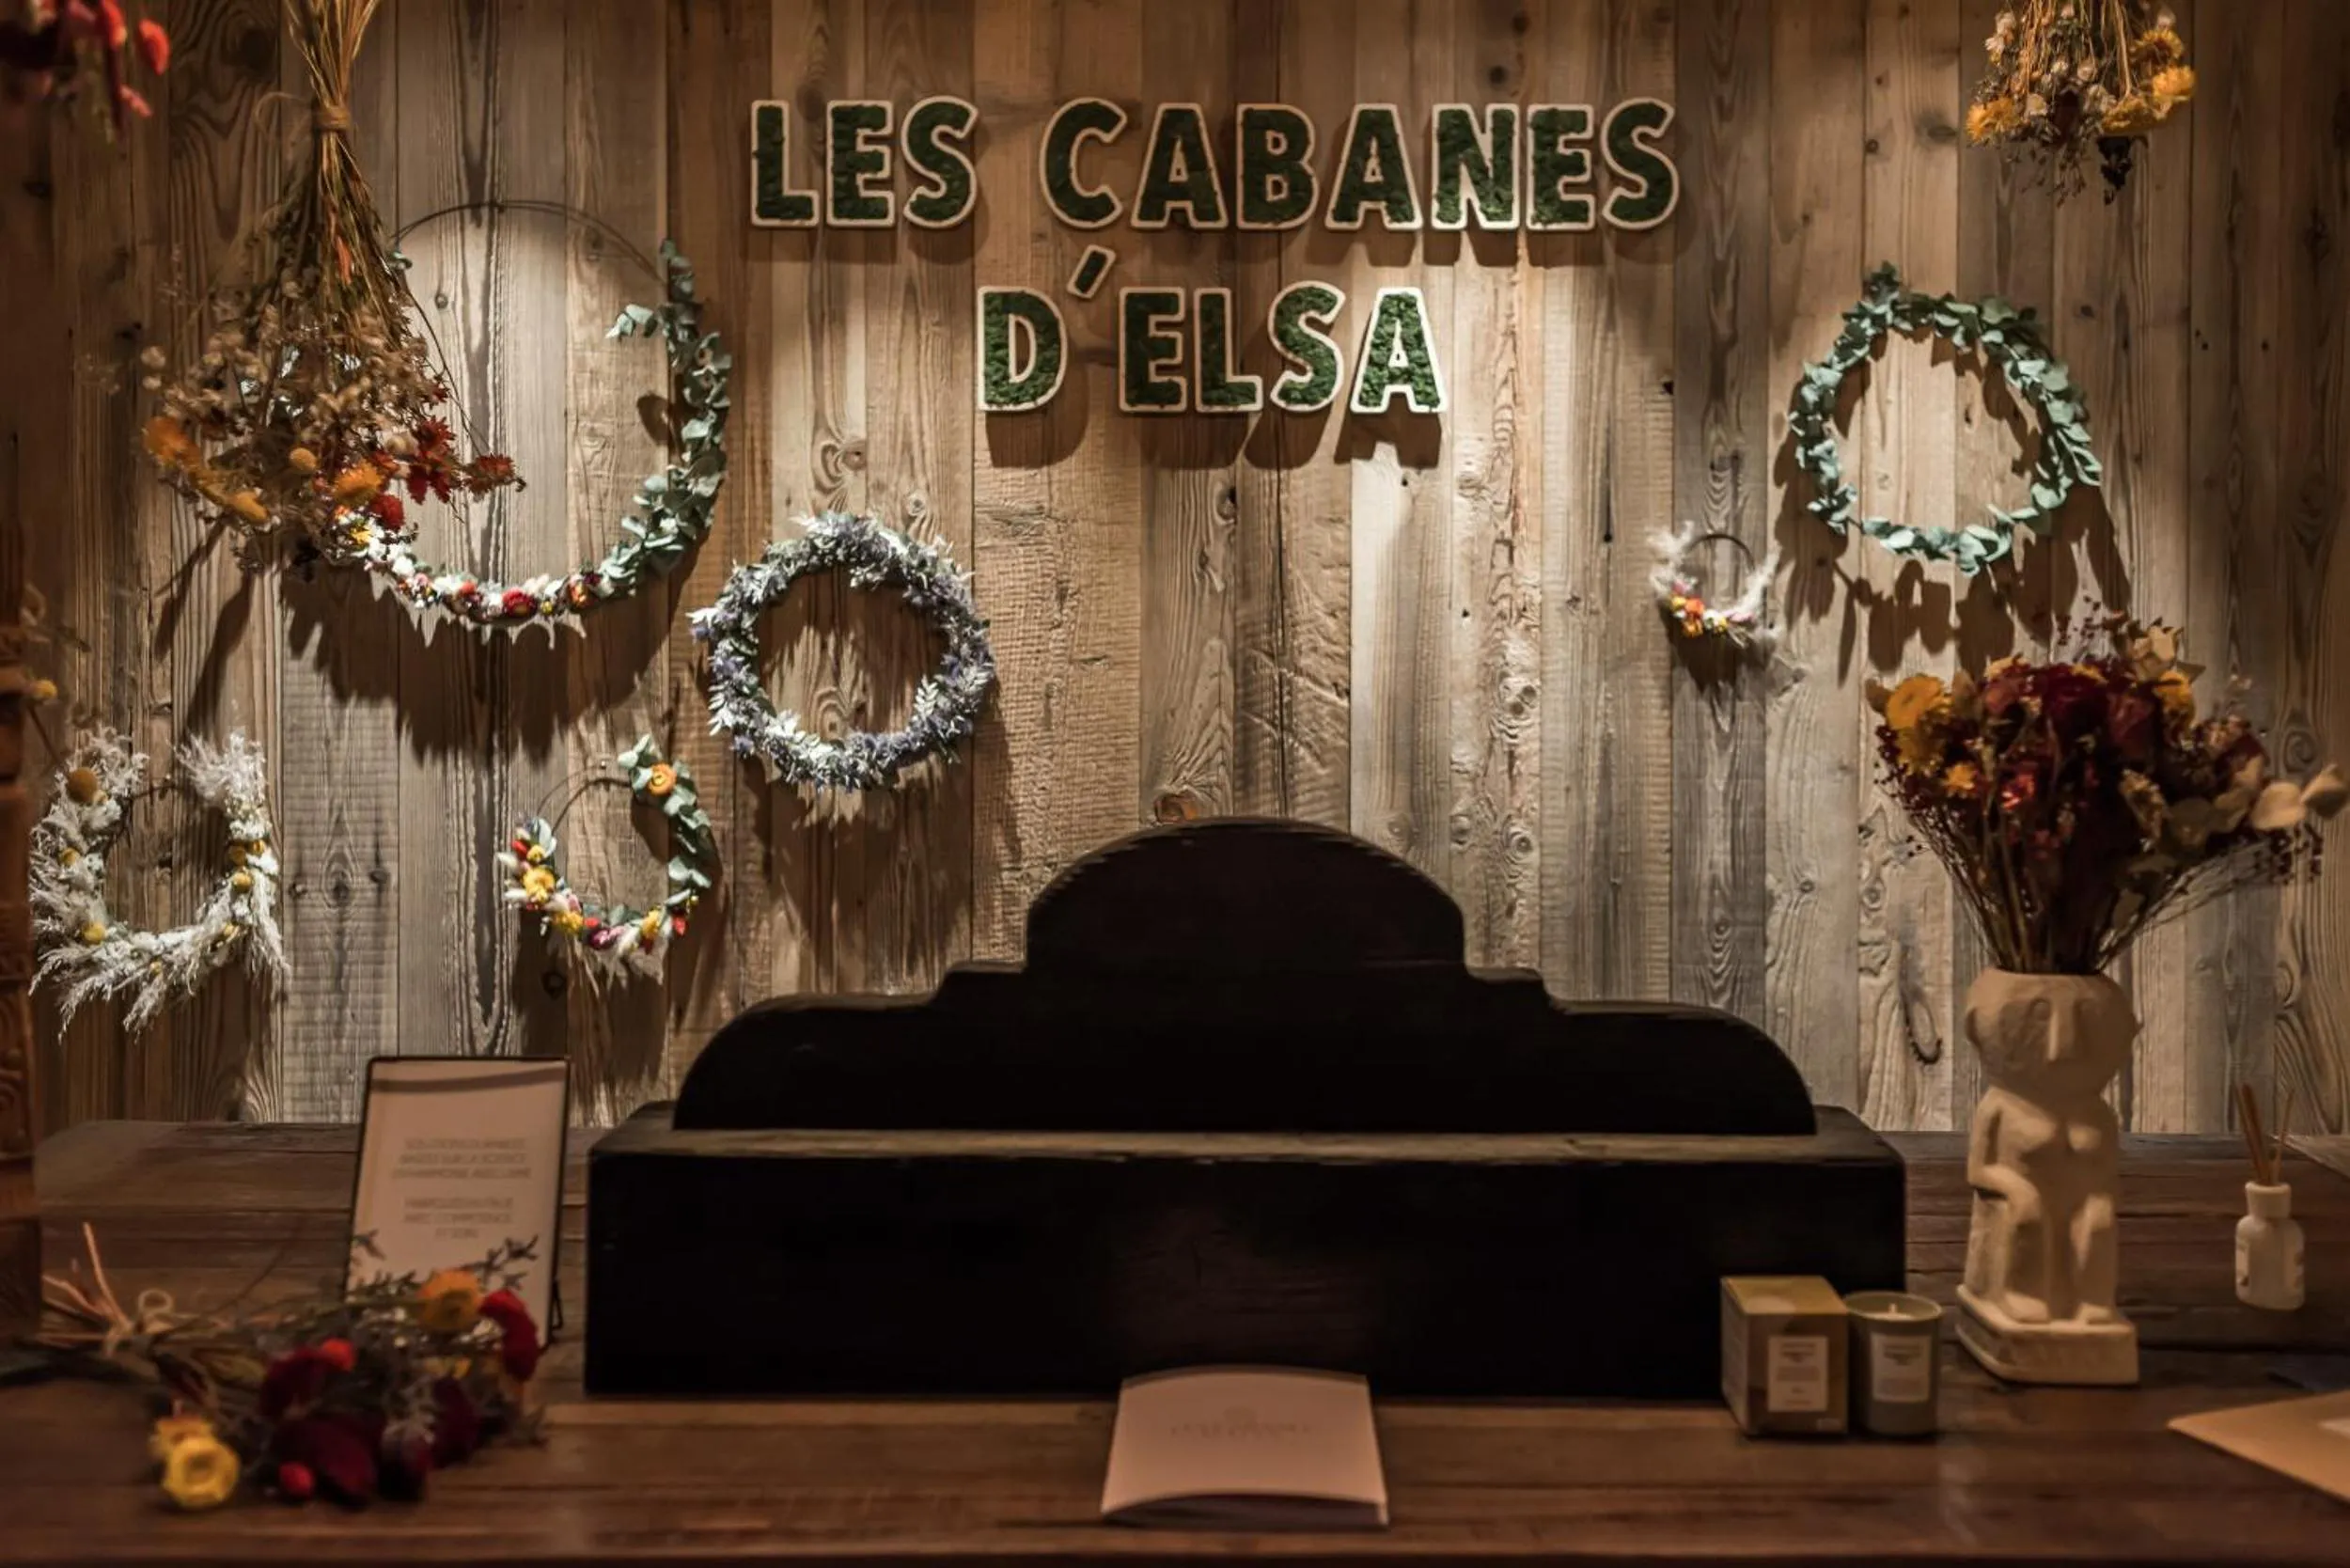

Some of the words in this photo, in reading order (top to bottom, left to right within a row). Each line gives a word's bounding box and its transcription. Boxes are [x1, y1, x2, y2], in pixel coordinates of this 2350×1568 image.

[749, 97, 979, 230] LES
[1039, 97, 1682, 232] CABANES
[975, 244, 1449, 416] D'ELSA
